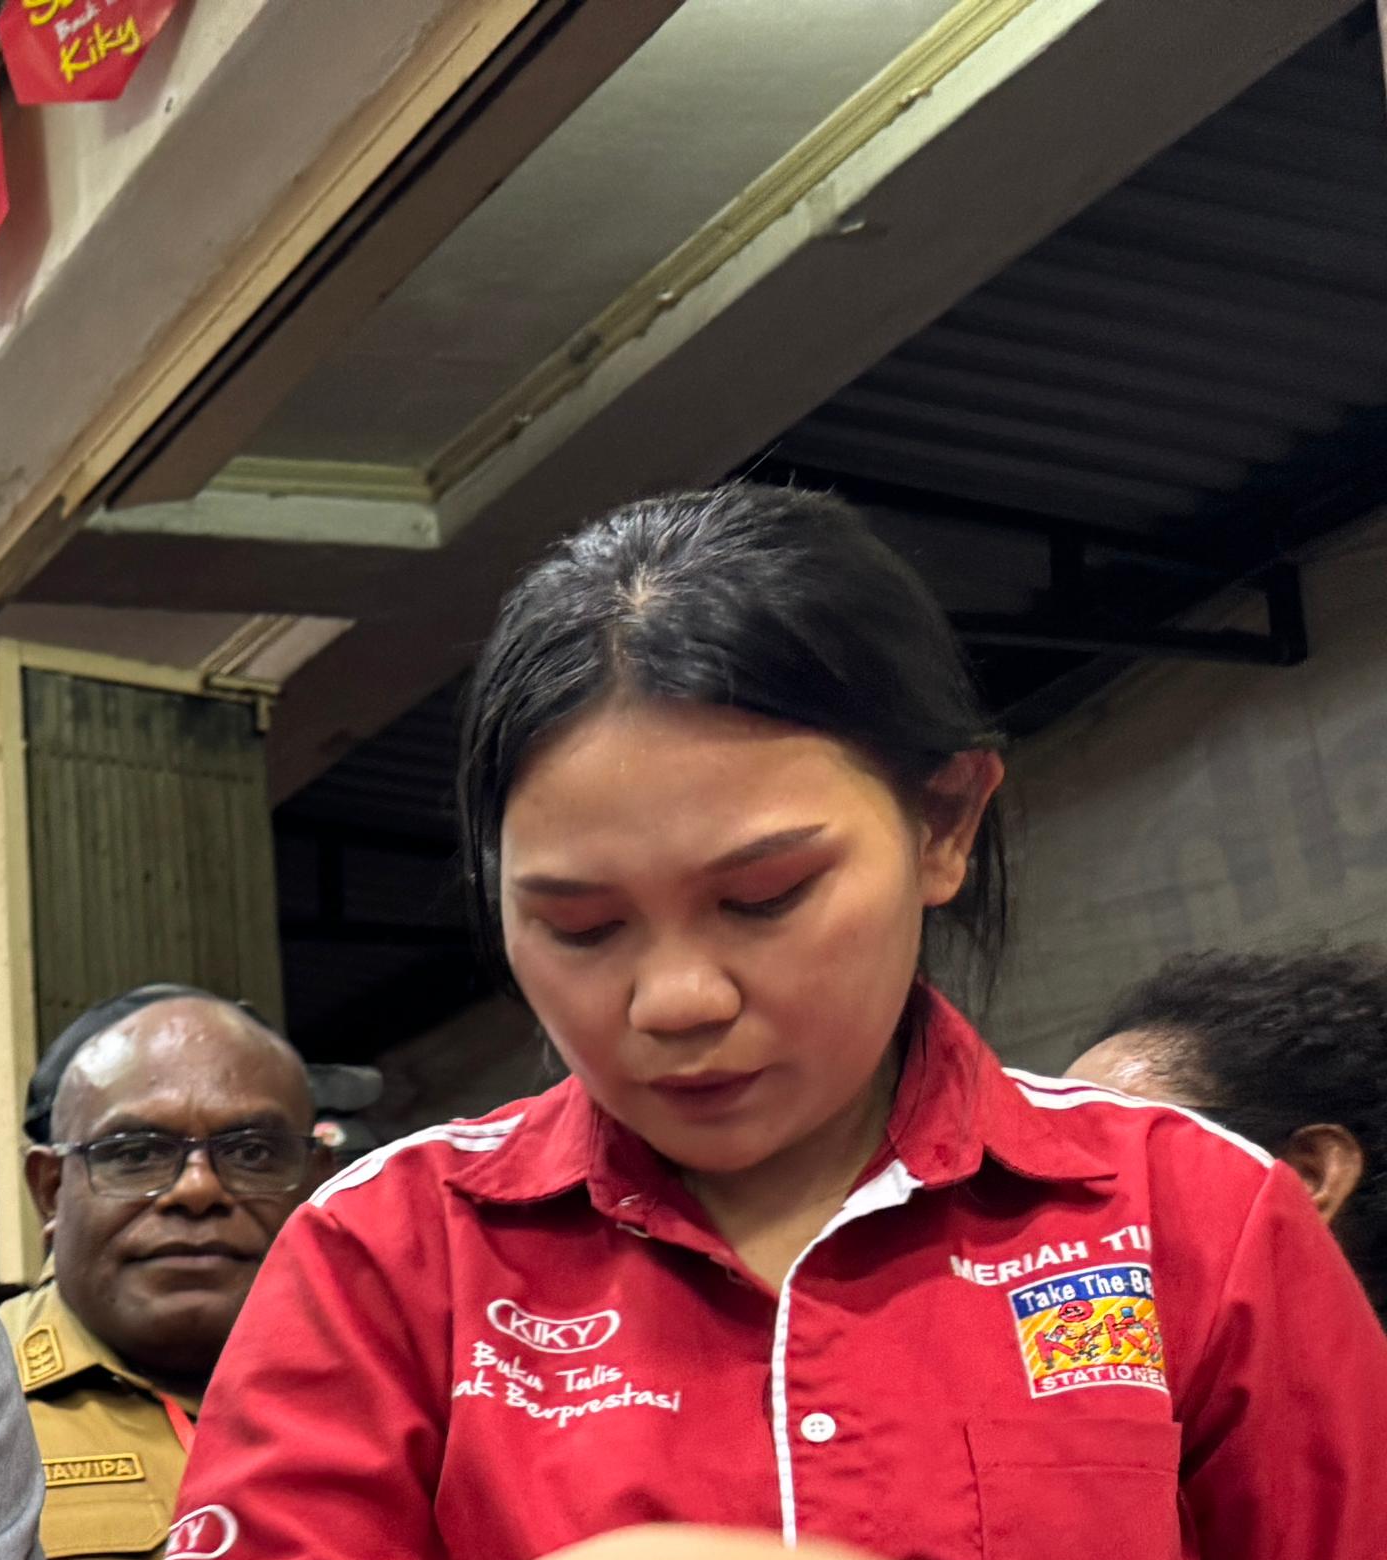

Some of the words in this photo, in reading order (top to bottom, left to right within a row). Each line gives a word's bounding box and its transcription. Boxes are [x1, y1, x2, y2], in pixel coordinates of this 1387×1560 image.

[60, 15, 141, 83] Kiky
[950, 1240, 1089, 1286] MERIAH
[1019, 1284, 1076, 1312] Take
[1079, 1274, 1125, 1296] The
[510, 1311, 596, 1348] KIKY
[471, 1340, 544, 1391] Buku
[555, 1364, 624, 1392] Tulis
[505, 1382, 681, 1428] Berprestasi
